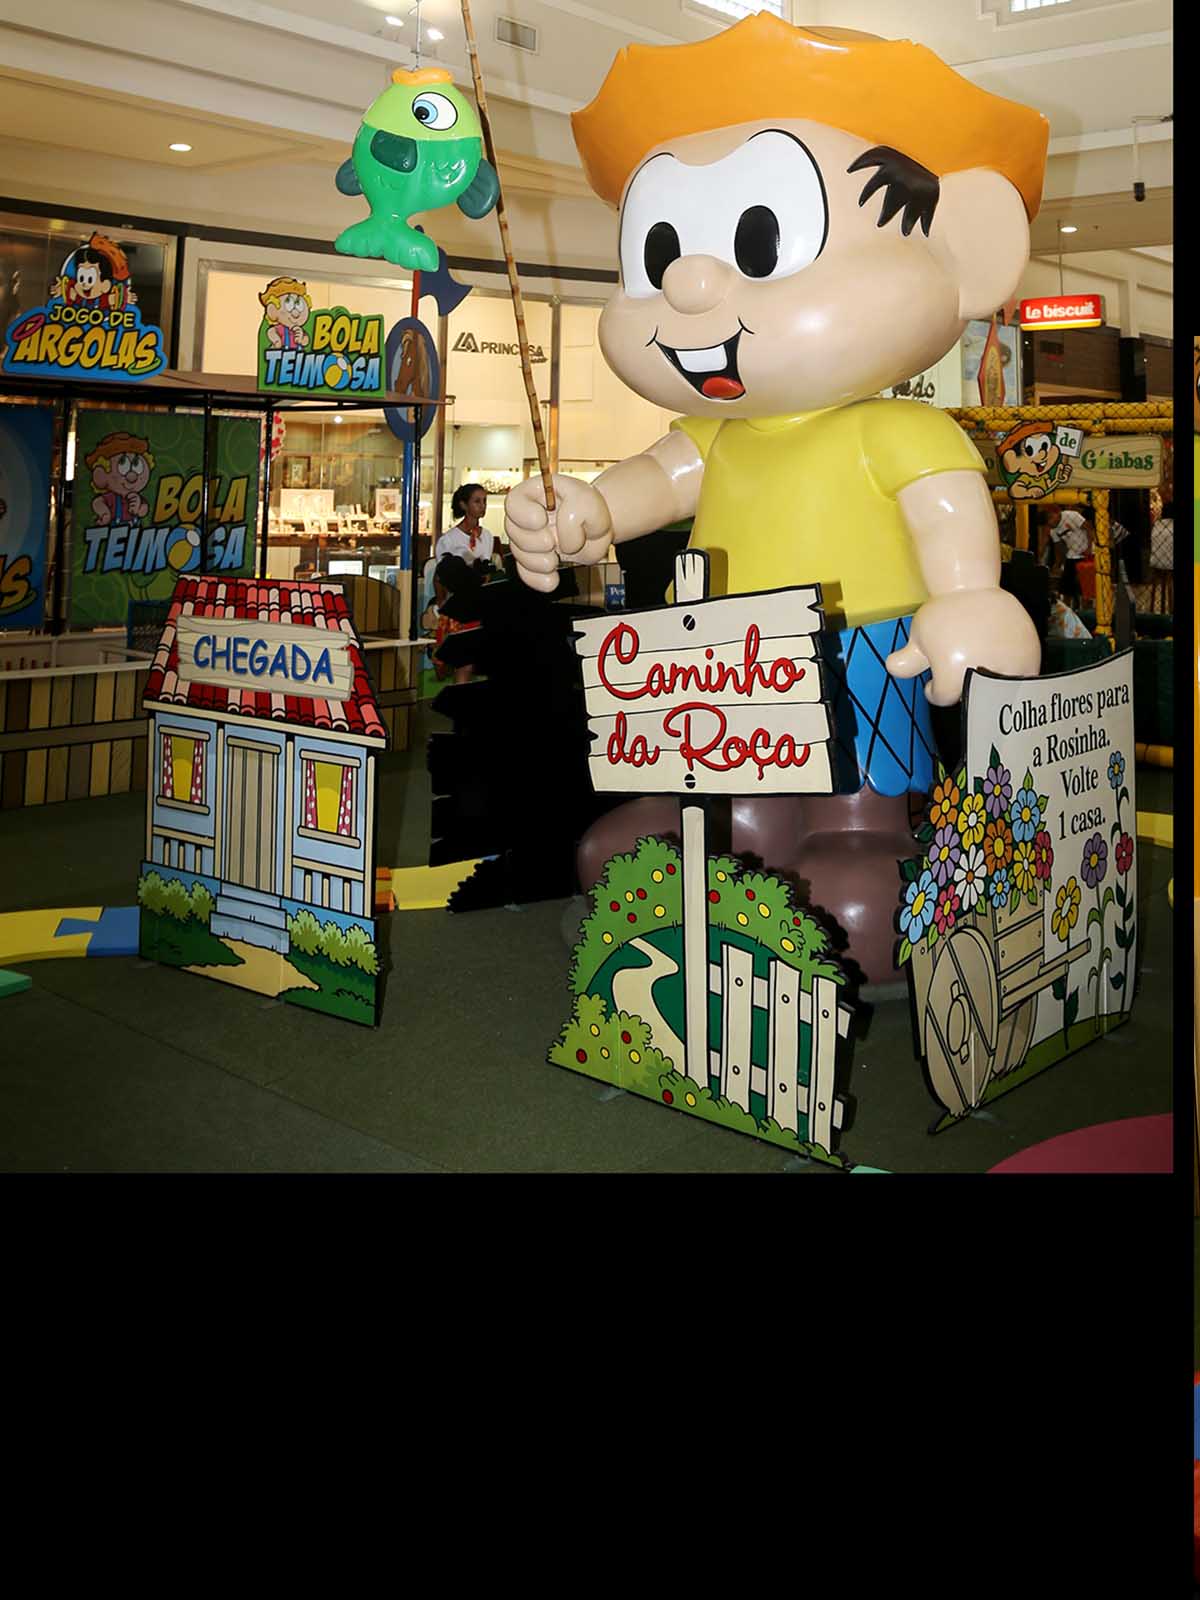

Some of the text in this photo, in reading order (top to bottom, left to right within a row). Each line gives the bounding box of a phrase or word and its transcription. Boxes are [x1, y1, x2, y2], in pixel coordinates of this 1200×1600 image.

[50, 305, 134, 328] JOGO DE
[1043, 301, 1095, 319] biscuit
[12, 322, 158, 370] ARGOLAS
[312, 314, 380, 354] BOLA
[480, 341, 544, 357] PRINCSA
[265, 349, 381, 390] TEIMOSA
[1059, 432, 1077, 449] de
[153, 474, 249, 523] BOLA
[193, 634, 335, 685] CHEGADA
[598, 622, 805, 700] Caminho
[999, 683, 1130, 736] Colha flores para
[607, 701, 811, 781] da Roça
[1033, 724, 1110, 768] a Rosinha.
[1060, 765, 1099, 798] Volte
[1058, 806, 1106, 841] 1 casa.
